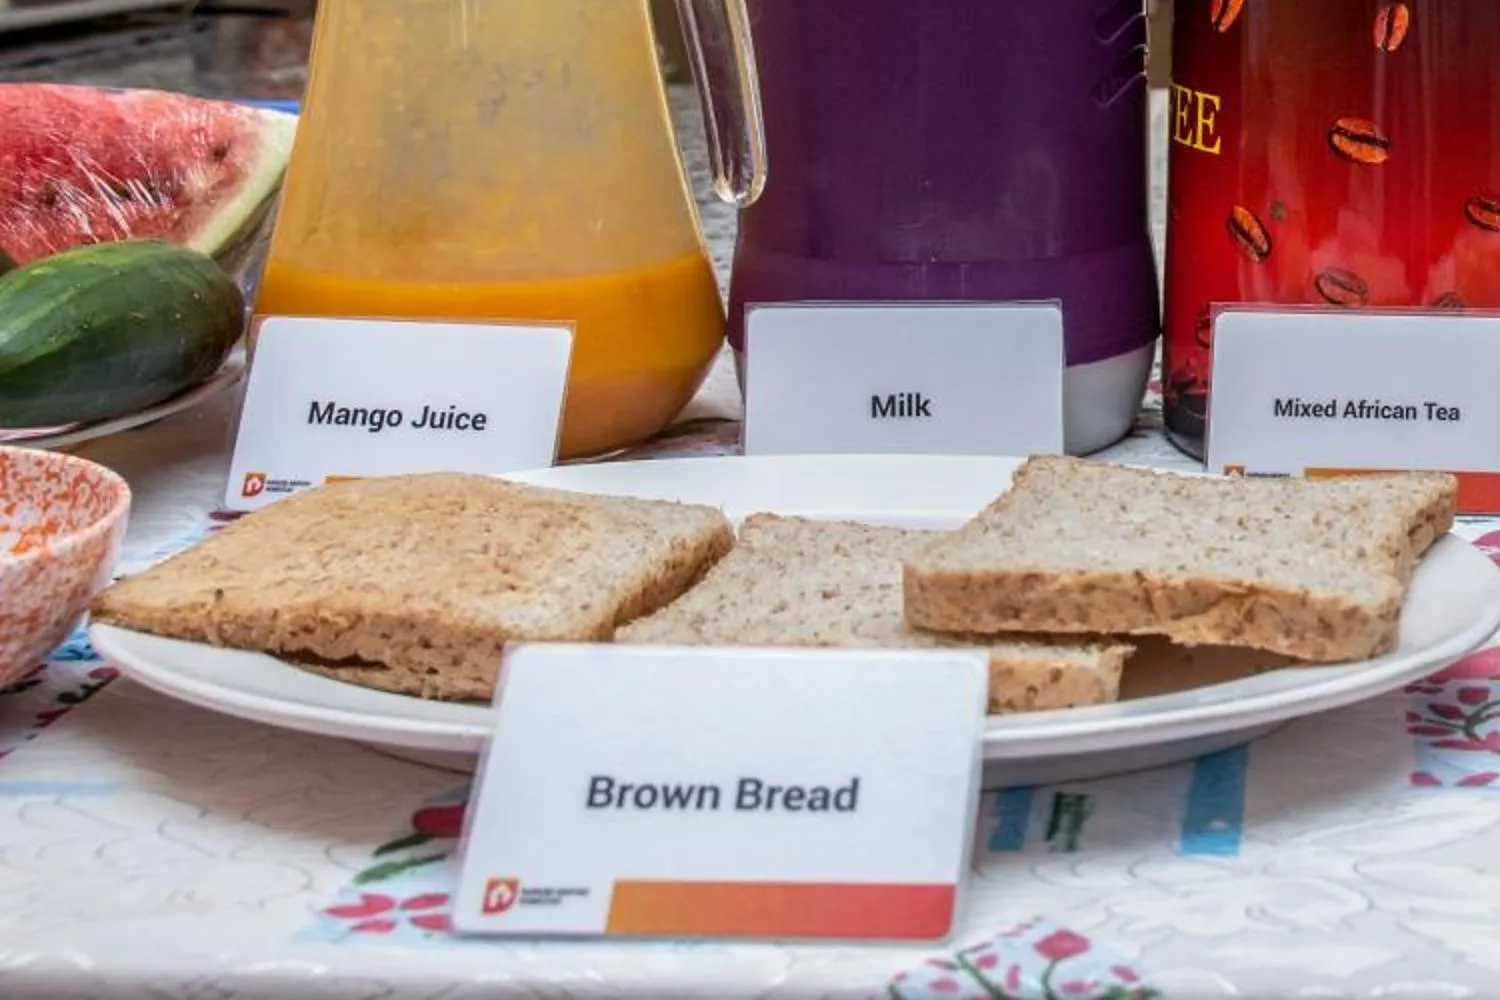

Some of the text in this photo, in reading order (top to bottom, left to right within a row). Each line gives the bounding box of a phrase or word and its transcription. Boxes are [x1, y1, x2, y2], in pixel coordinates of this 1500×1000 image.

[1170, 82, 1222, 155] EE
[307, 401, 488, 433] Mango Juice
[871, 393, 932, 418] Milk
[1273, 397, 1461, 422] Mixed African Tea
[585, 775, 861, 813] Brown Bread
